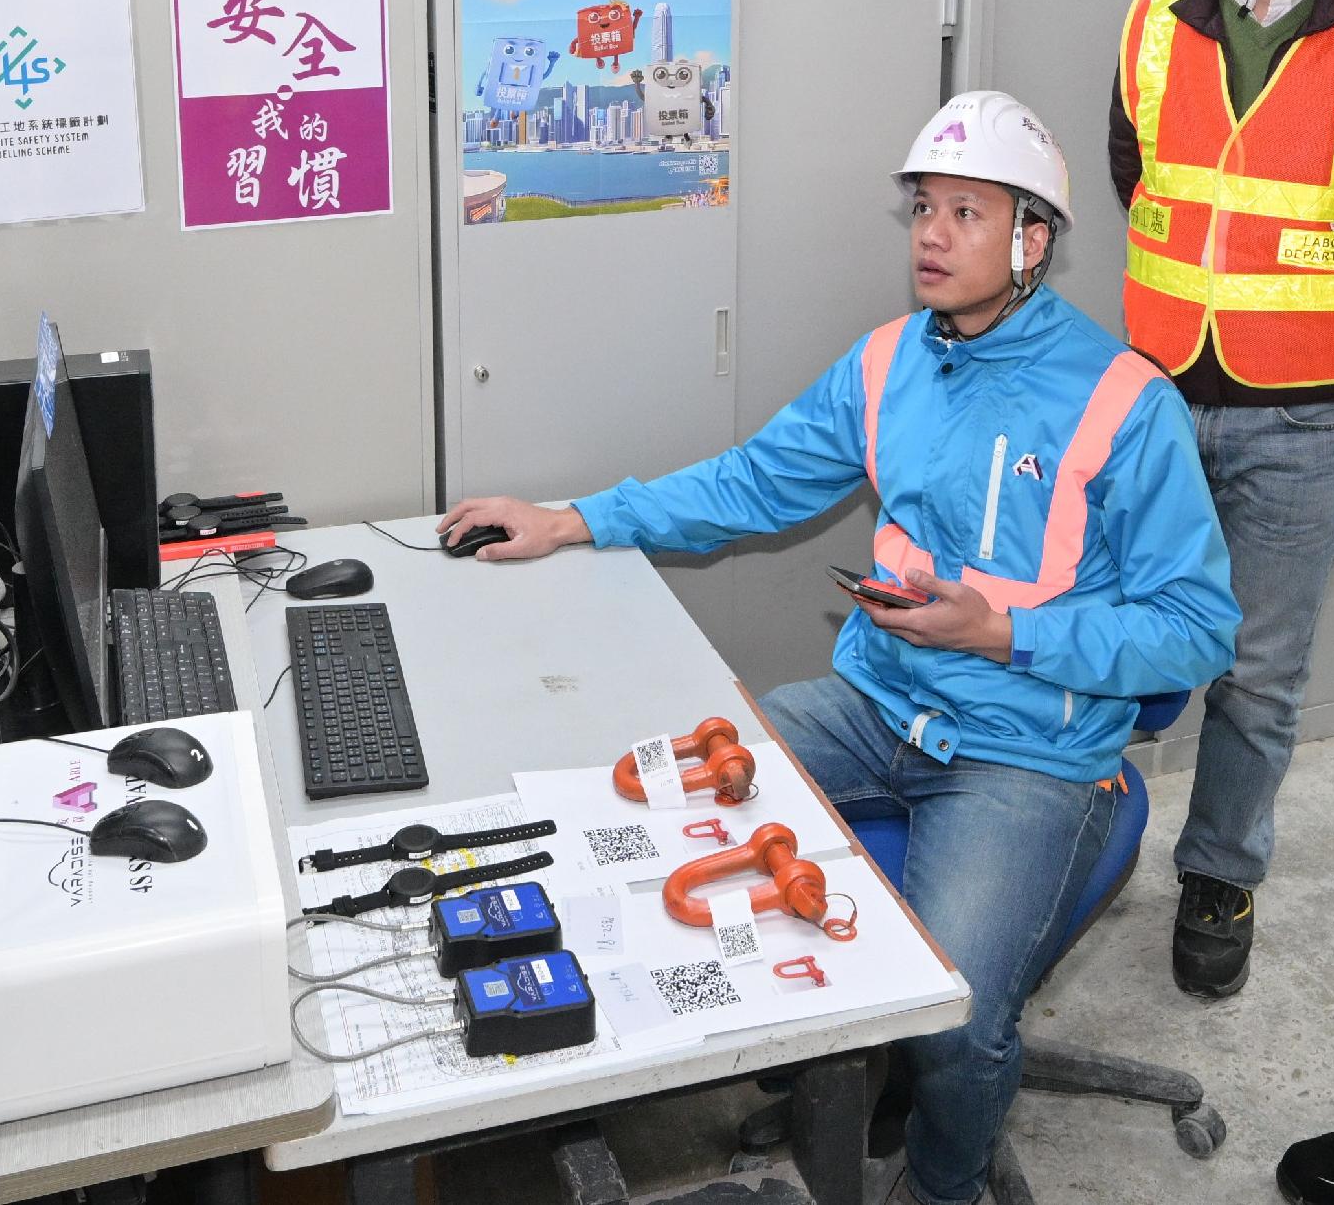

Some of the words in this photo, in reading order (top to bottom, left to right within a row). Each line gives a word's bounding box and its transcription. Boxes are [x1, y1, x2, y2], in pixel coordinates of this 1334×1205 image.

[591, 31, 622, 46] 投票箱
[251, 99, 328, 142] 我的
[658, 108, 689, 121] 投票箱
[18, 135, 51, 146] SAFETY
[55, 132, 89, 143] SYSTEM
[35, 145, 71, 156] SCHEME
[226, 145, 347, 211] 習慣
[190, 749, 203, 762] 2
